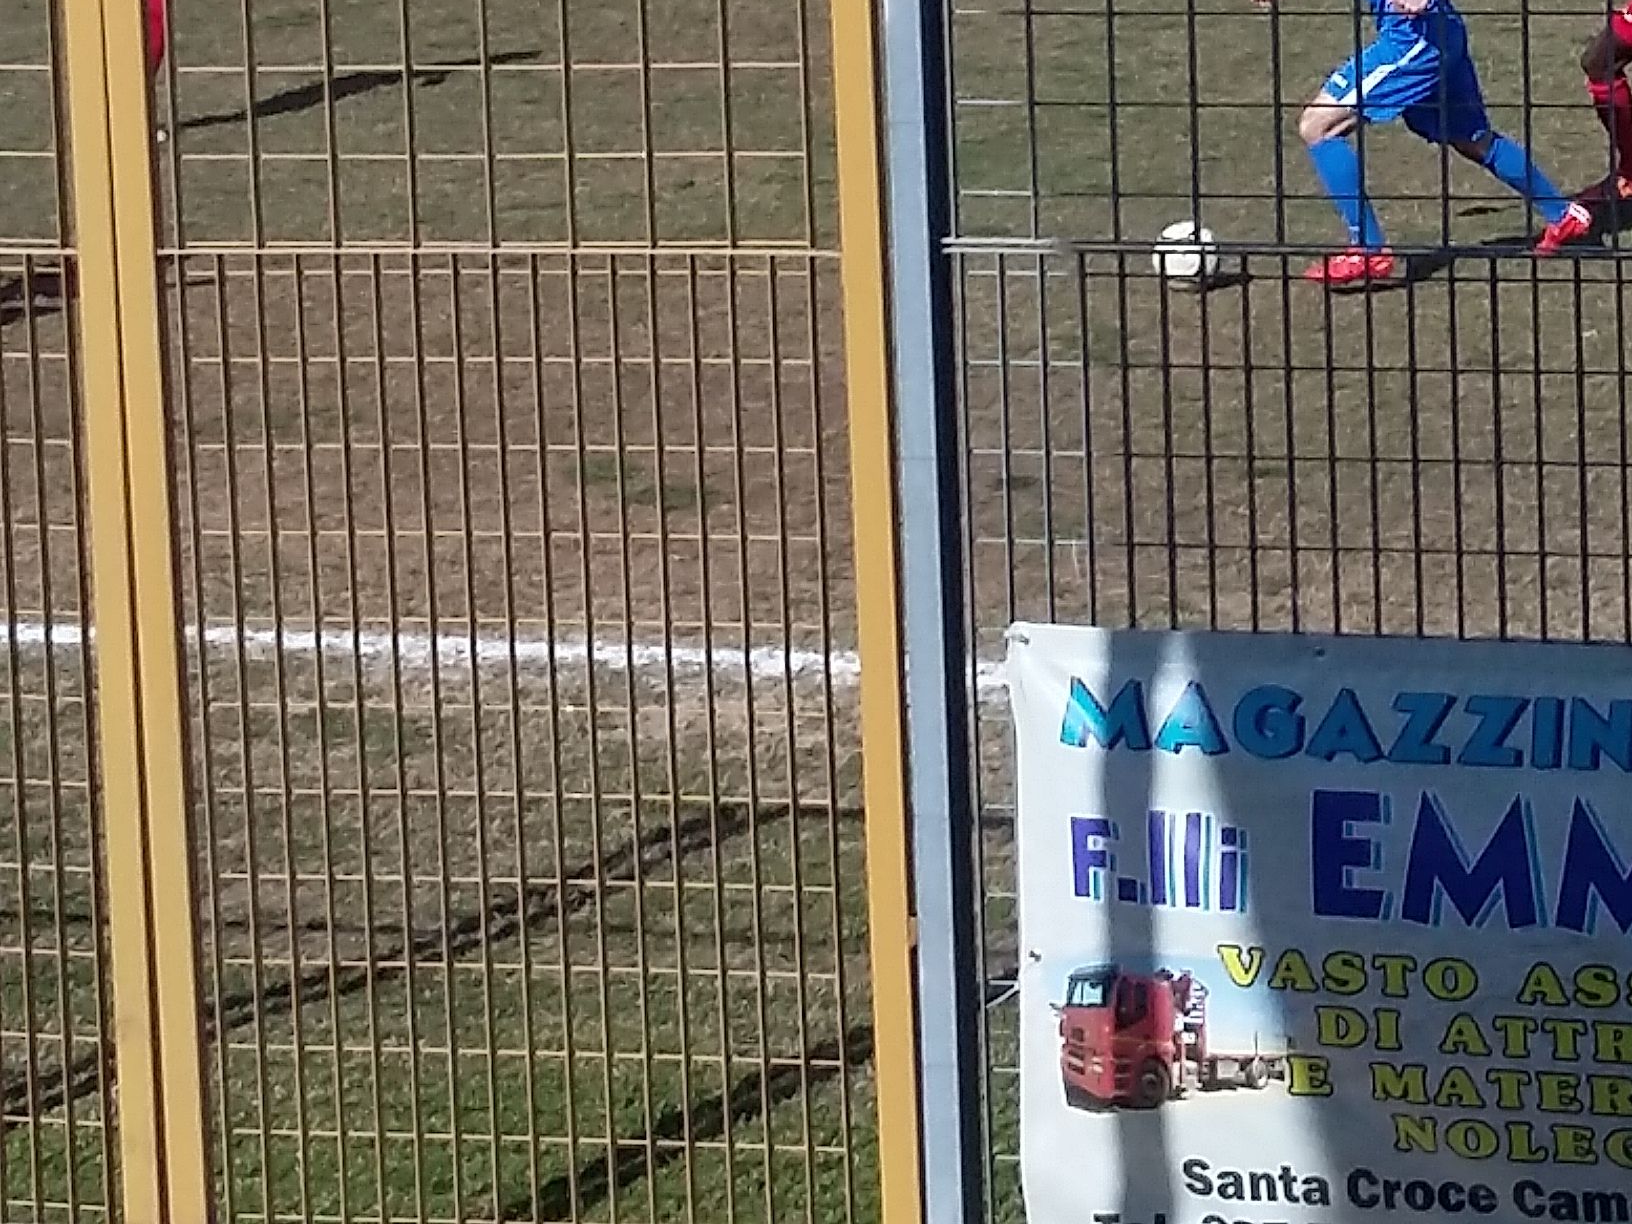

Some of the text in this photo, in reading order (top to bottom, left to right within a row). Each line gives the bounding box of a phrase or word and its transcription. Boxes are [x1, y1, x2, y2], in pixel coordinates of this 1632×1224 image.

[1070, 808, 1249, 914] F.lli
[1217, 943, 1479, 1002] VASTO
[1315, 1005, 1403, 1051] DI
[1286, 1055, 1333, 1096] E
[1182, 1158, 1331, 1207] Santa
[1346, 1168, 1498, 1213] Croce
